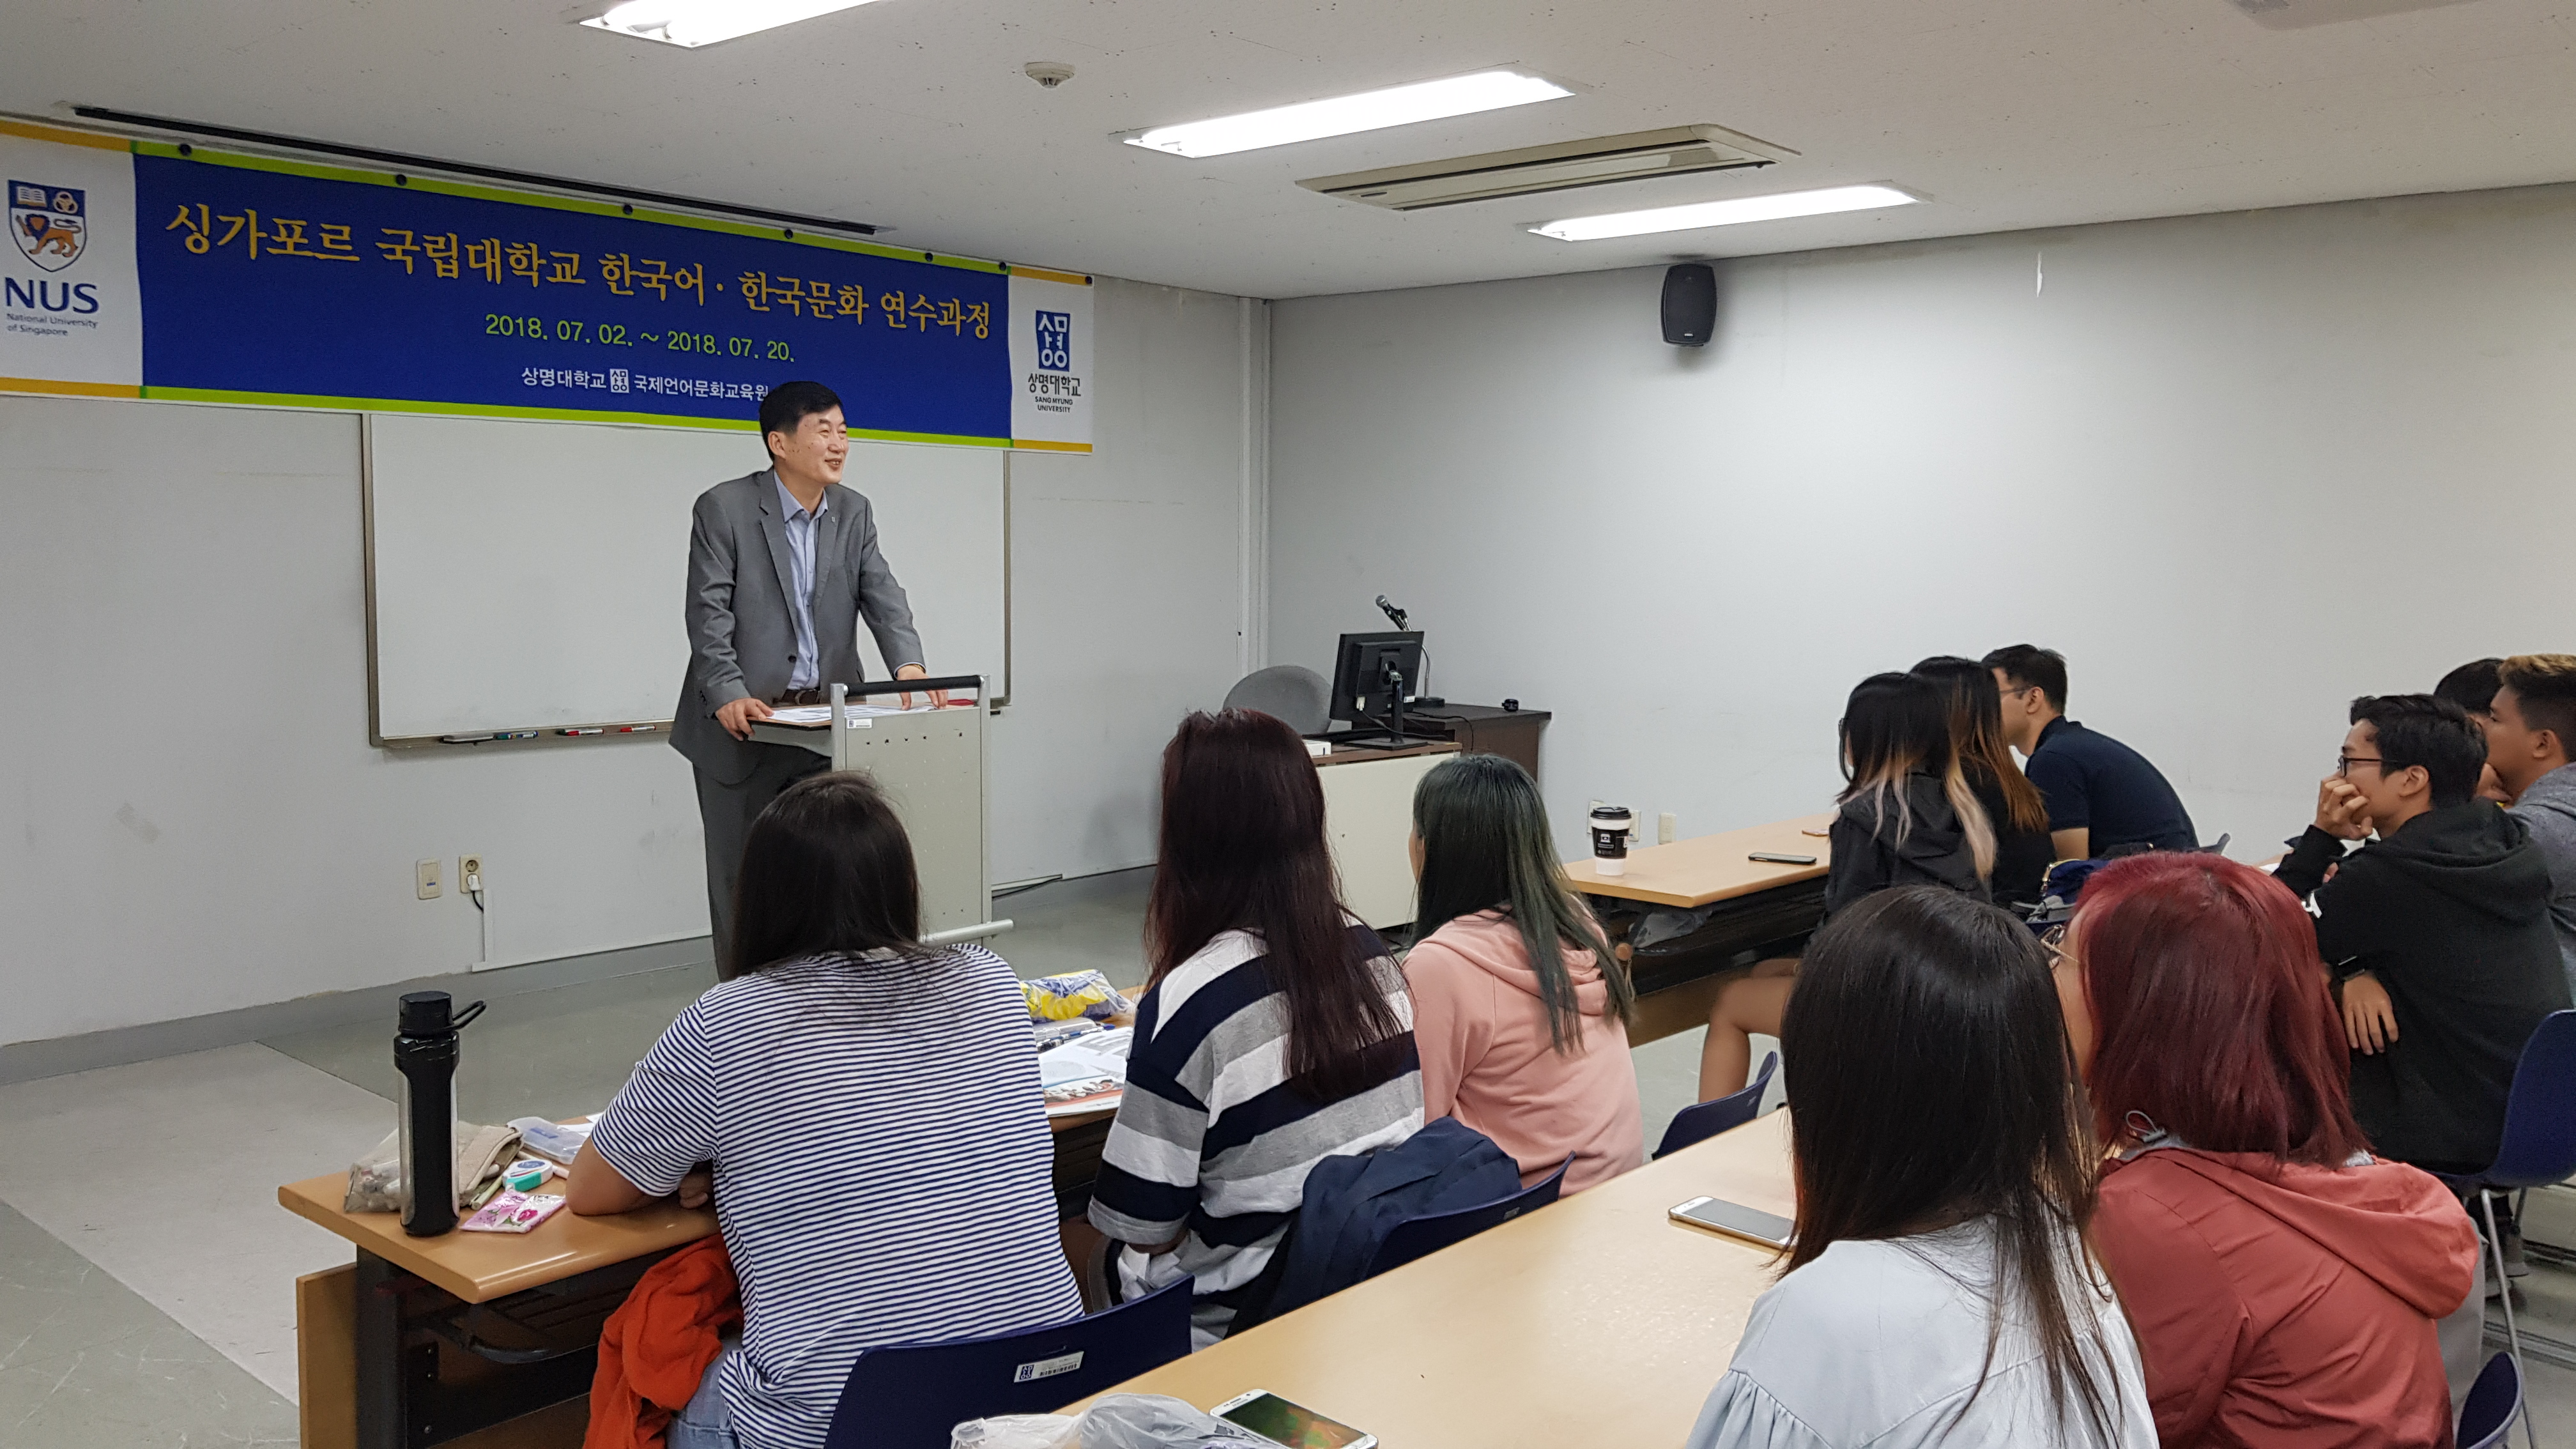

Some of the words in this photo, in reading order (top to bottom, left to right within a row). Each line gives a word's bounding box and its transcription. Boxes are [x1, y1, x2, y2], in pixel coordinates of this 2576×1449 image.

[166, 203, 360, 261] 싱가포르
[376, 227, 585, 287] 국립대학교
[601, 254, 705, 306] 한국어
[739, 271, 869, 325] 한국문화
[880, 291, 990, 339] 연수과정
[5, 277, 99, 314] NUS
[6, 313, 47, 323] National
[50, 317, 98, 328] University
[20, 325, 68, 336] Singapore
[486, 314, 548, 340] 2018.
[668, 331, 722, 356] 2018.
[521, 367, 606, 390] 상명대학교
[634, 374, 769, 402] 국제언어문화교육원
[1028, 373, 1081, 397] 상명대학교
[1037, 404, 1071, 413] UNIVERSITY
